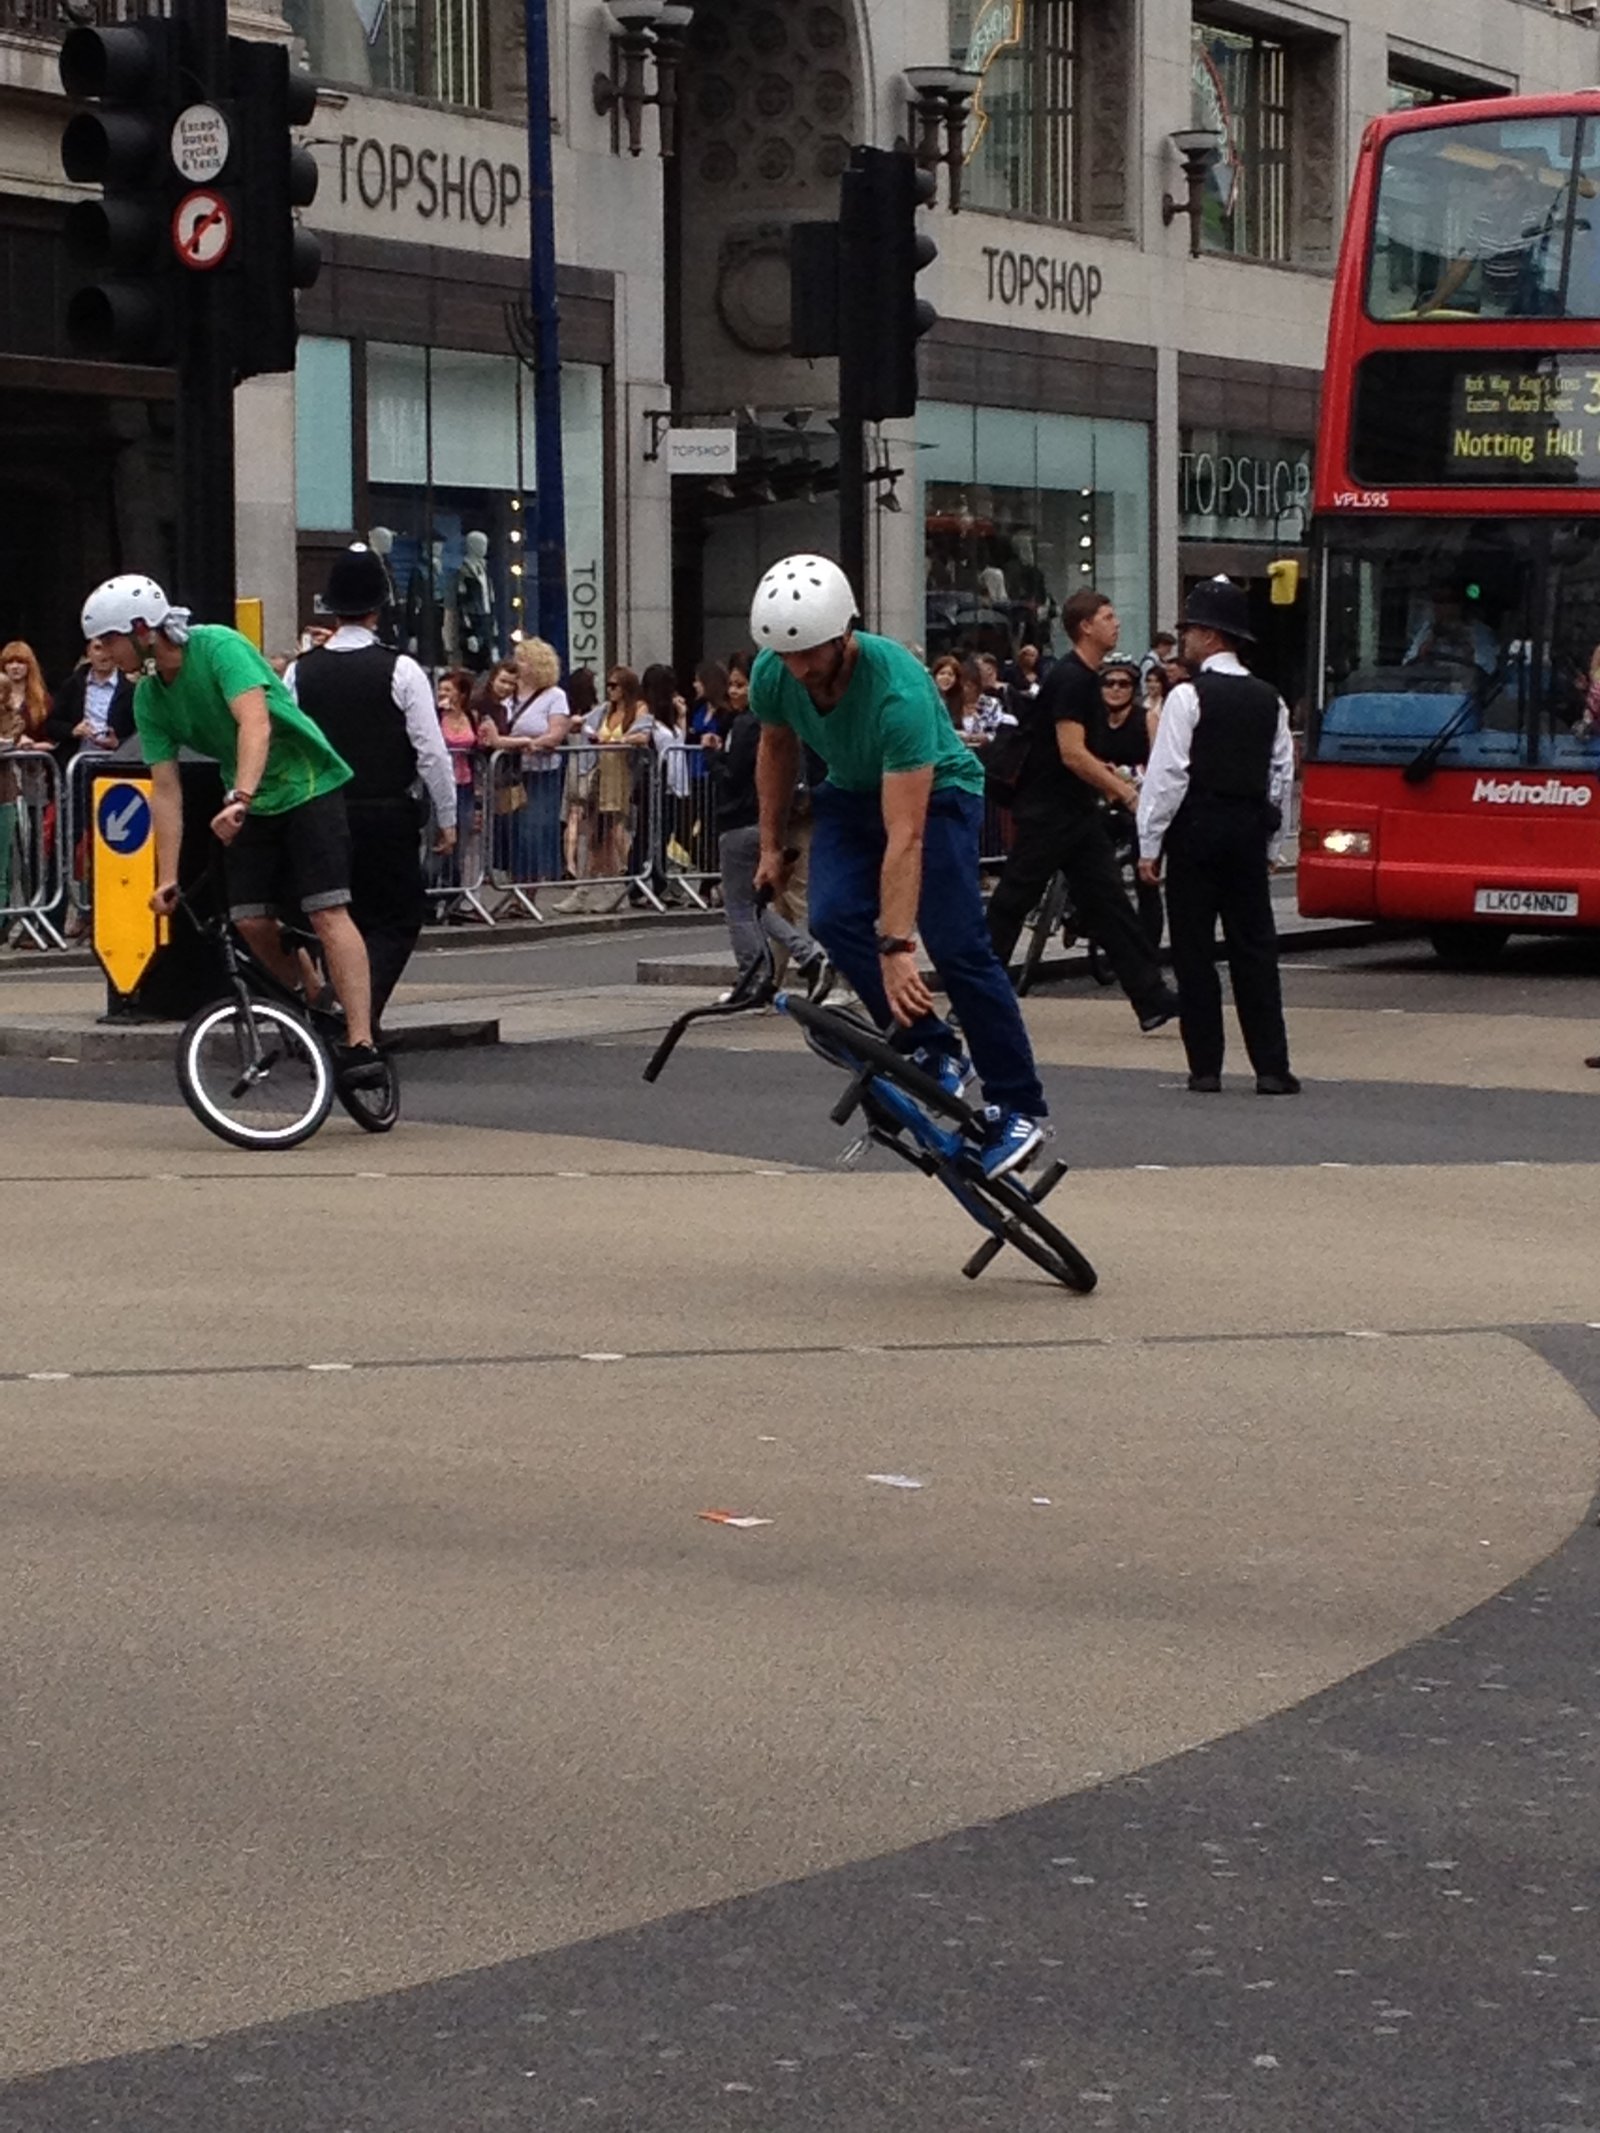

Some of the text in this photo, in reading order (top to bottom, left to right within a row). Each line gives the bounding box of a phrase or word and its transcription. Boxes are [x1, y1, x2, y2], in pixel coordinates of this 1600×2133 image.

[180, 119, 220, 134] Except
[338, 134, 522, 228] TOPSHOP
[982, 246, 1102, 316] TOPSHOP
[672, 444, 730, 457] TOPSHOP
[1453, 428, 1535, 463] Notting
[1545, 428, 1583, 456] Hill
[1179, 453, 1311, 517] TOPSHOP
[1472, 778, 1592, 806] Metroline
